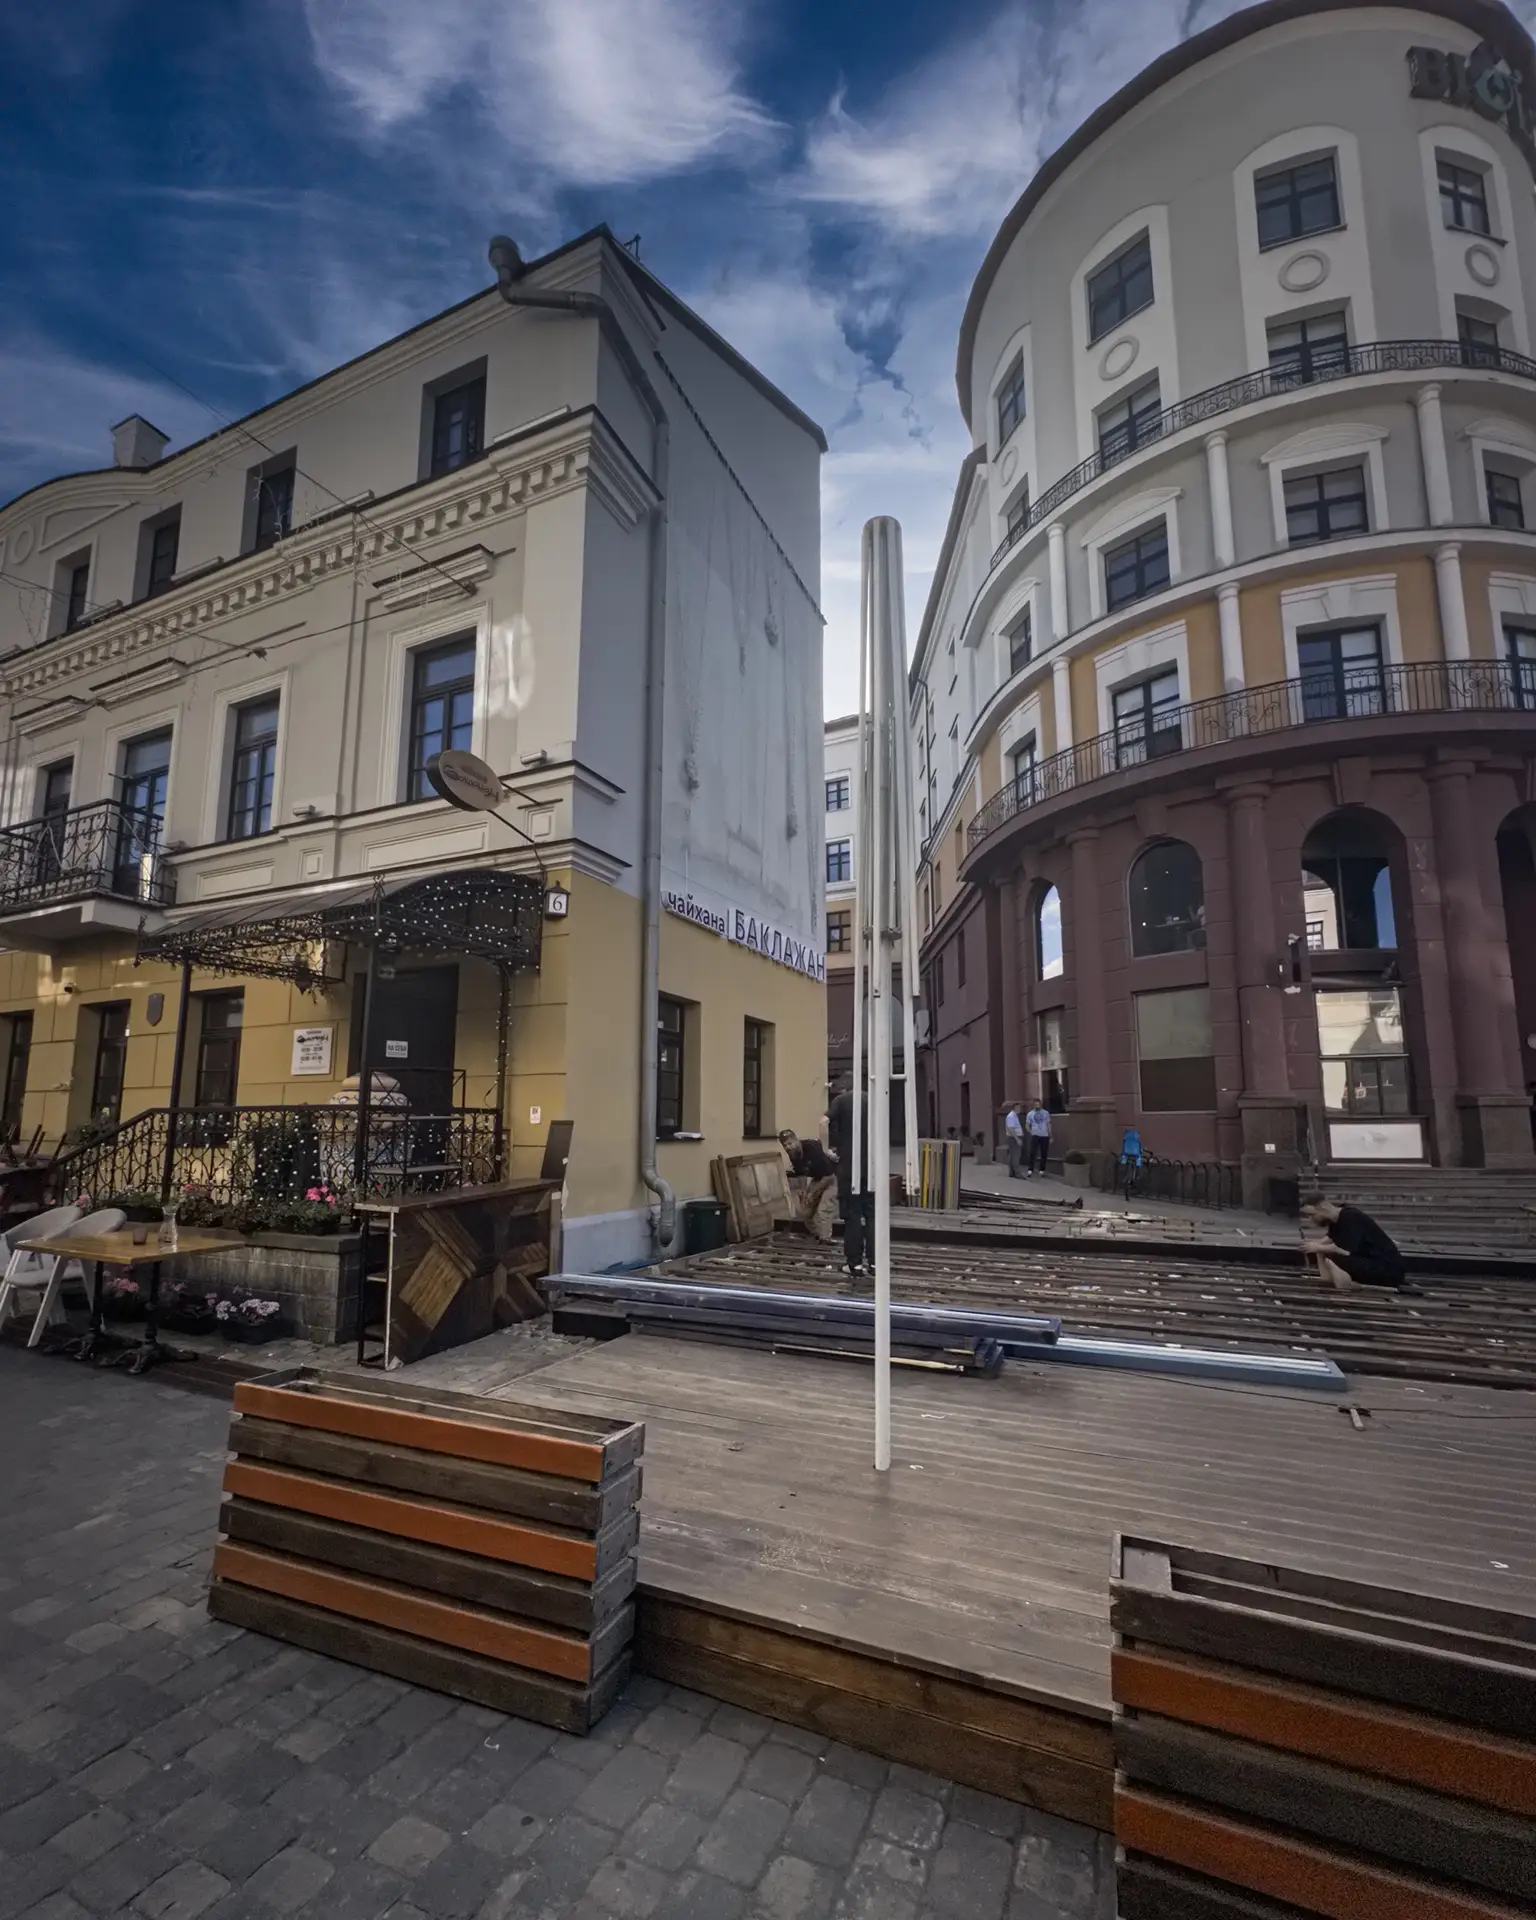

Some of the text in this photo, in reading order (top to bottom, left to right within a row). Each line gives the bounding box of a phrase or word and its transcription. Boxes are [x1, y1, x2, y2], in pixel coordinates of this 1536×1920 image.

[553, 895, 563, 911] 6
[668, 892, 825, 981] чайхана БАКЛАЖАН
